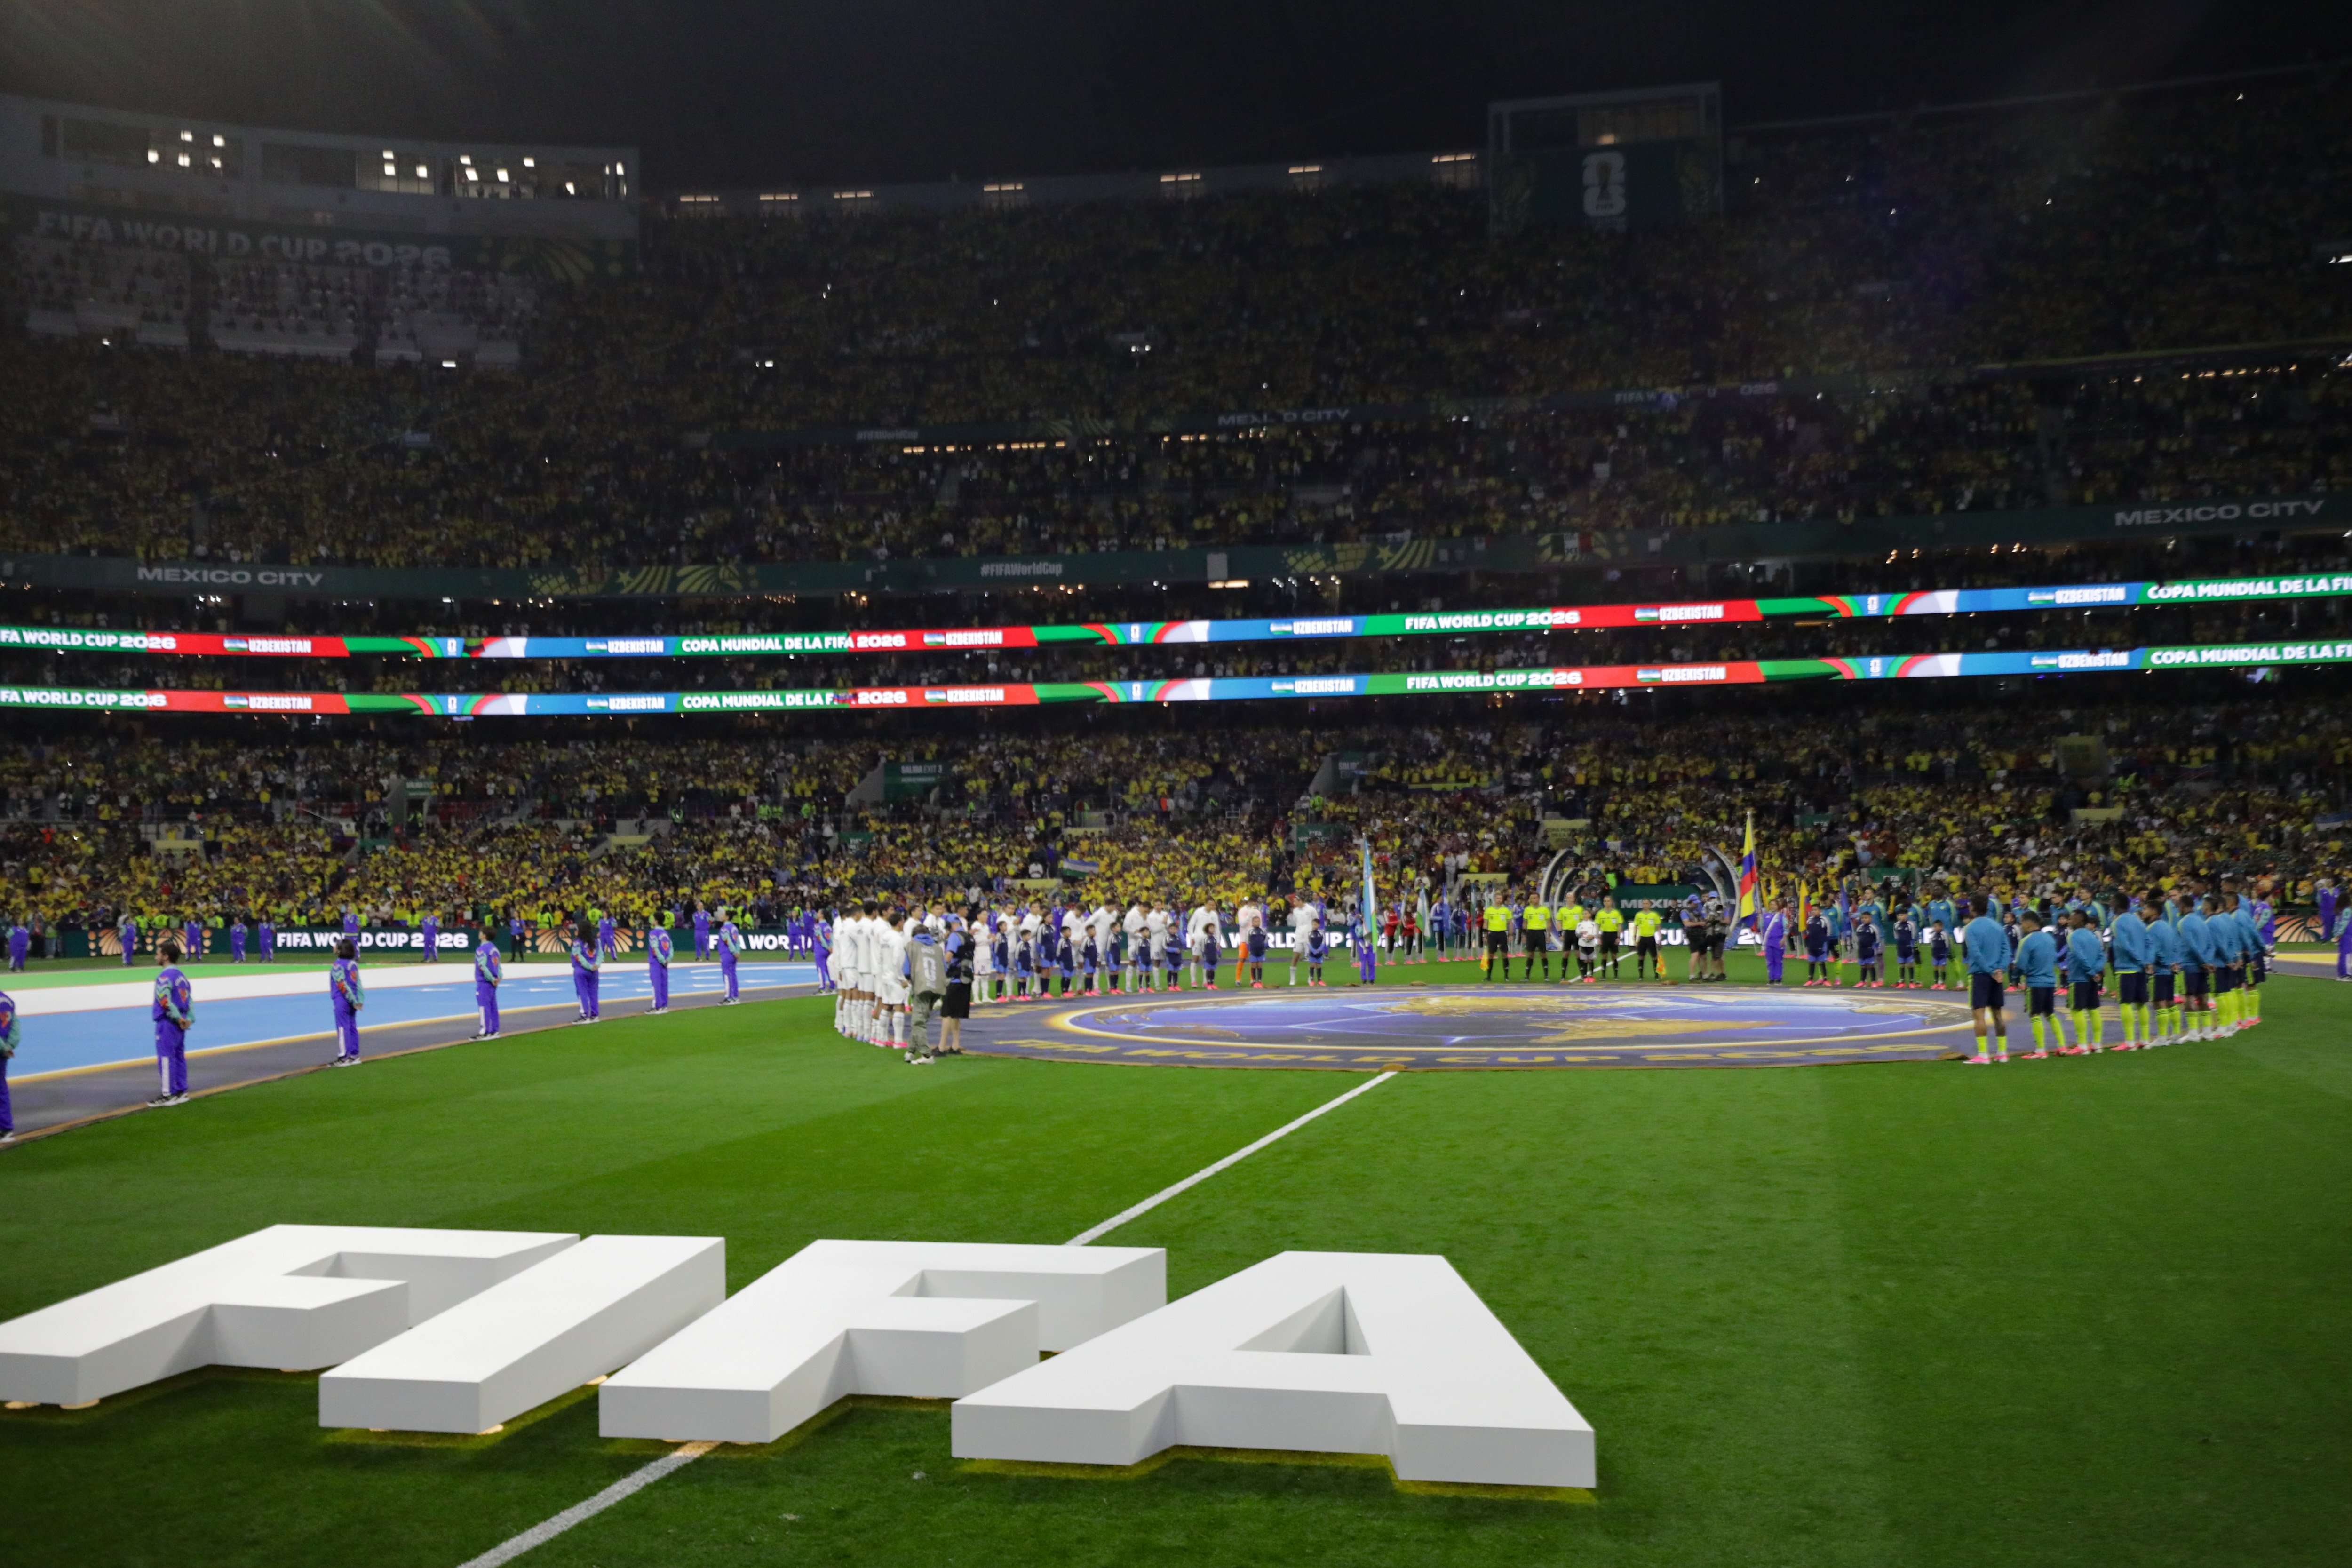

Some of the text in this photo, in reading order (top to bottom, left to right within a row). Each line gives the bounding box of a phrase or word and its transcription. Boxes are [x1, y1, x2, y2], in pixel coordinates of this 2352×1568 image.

[37, 210, 113, 242] FIFA
[259, 234, 328, 262] CUP
[1217, 408, 1351, 426] MEXIO CITY
[2114, 499, 2325, 526] MEXICO CITY
[137, 566, 324, 587] MEXICO CITY
[2055, 586, 2126, 604] UZBEKISTAN
[2147, 584, 2197, 600] COPA
[2197, 581, 2278, 597] MUNDIAL
[2280, 579, 2304, 594] DE
[2305, 578, 2330, 592] LA
[1405, 610, 1581, 630] FIFA WORLD CUP 2026
[1659, 605, 1724, 621] UZBEKISTAN
[1293, 619, 1353, 634] UZBEKISTAN
[22, 630, 83, 646] WORLD
[84, 633, 118, 647] CUP
[119, 635, 176, 650] 2026
[248, 639, 312, 653] UZBEKISTAN
[607, 639, 664, 653] UZBEKISTAN
[682, 634, 906, 653] COPA MUNDIAL DE LA FIFA 2026
[946, 631, 1003, 645] UZBEKISTAN
[2058, 651, 2129, 668] UZBEKISTAN
[2150, 649, 2200, 665] COPA
[2200, 646, 2281, 663] MUNDIAL
[2282, 645, 2307, 660] DE
[2309, 644, 2334, 659] LA
[1406, 670, 1583, 690] FIFA WORLD CUP 2026
[1661, 666, 1726, 682] UZBEKISTAN
[1295, 678, 1355, 693] UZBEKISTAN
[22, 690, 83, 705] WORLD
[84, 692, 118, 706] CUP
[248, 695, 312, 710] UZBEKISTAN
[609, 696, 665, 710] UZBEKISTAN
[683, 694, 721, 709] COPA
[722, 693, 784, 708] MUNDIAL
[785, 693, 804, 707] DE
[805, 692, 824, 706] LA
[857, 690, 908, 705] 2026
[947, 688, 1005, 702] UZBEKISTAN
[277, 932, 313, 947] FIFA
[375, 932, 409, 948] CUP
[410, 932, 469, 948] 226
[1122, 1049, 1416, 1064] WORLD
[0, 1224, 1596, 1487] FIFA
